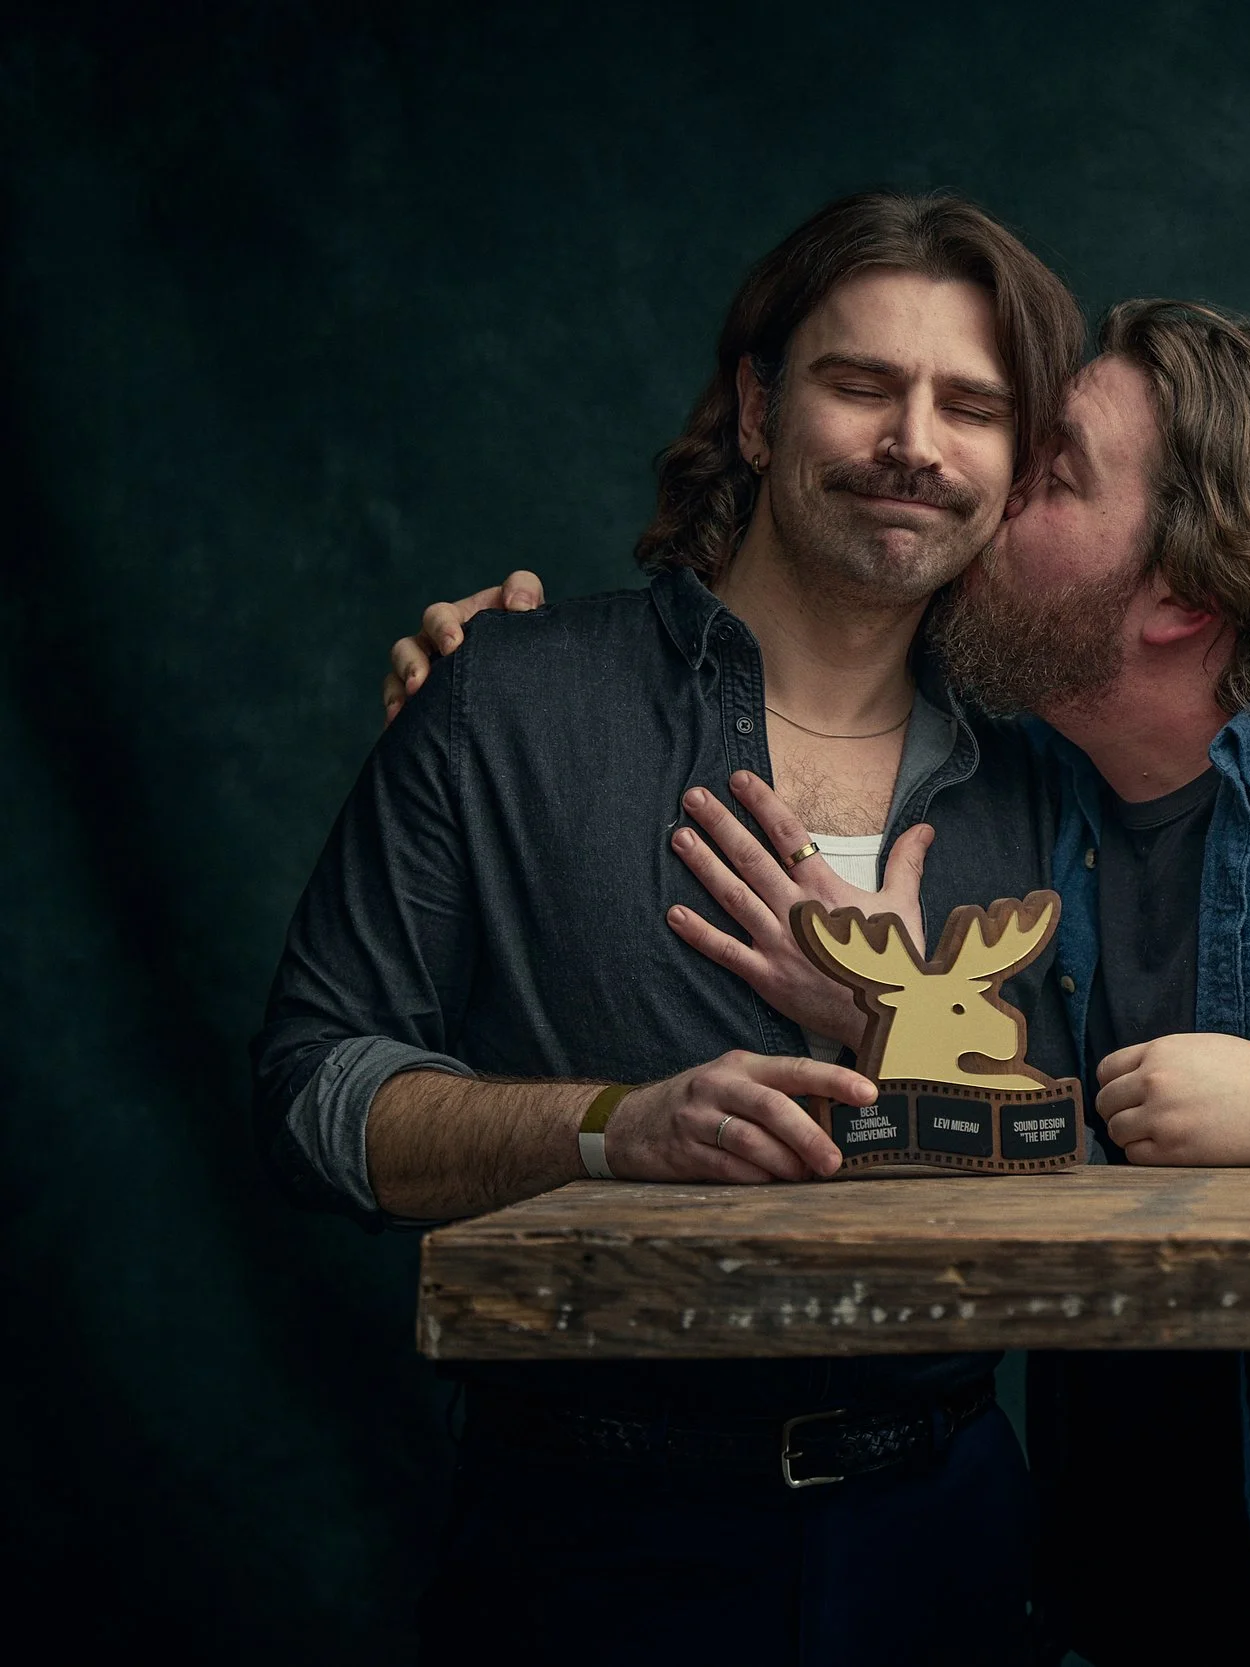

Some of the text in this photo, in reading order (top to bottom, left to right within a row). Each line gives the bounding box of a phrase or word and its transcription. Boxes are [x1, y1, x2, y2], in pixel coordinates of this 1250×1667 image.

[860, 1106, 878, 1117] BEST
[851, 1117, 891, 1130] TECHNICAL
[934, 1118, 979, 1133] LEVI MIERAU
[1013, 1118, 1065, 1132] SOUND DESIGN
[846, 1127, 897, 1143] ACHIEVEMENT
[1020, 1130, 1060, 1143] "THE HEIR"
